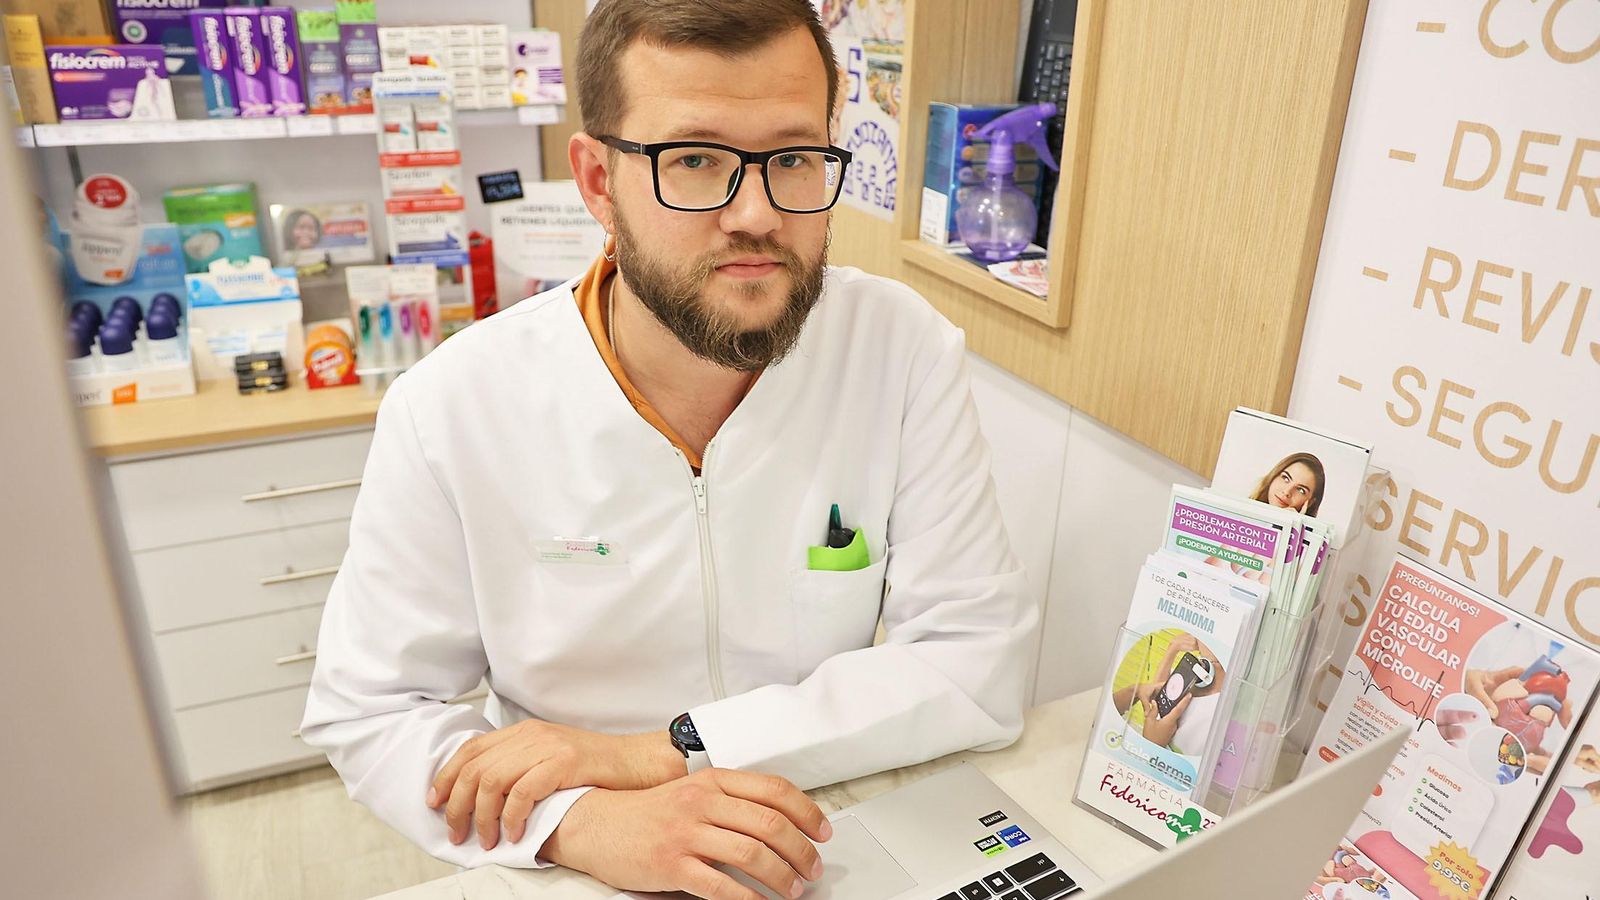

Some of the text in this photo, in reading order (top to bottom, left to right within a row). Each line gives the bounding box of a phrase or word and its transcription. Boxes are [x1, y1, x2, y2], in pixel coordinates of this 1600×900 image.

[51, 52, 126, 70] fisiocrem
[1443, 120, 1600, 218] DER
[1413, 246, 1600, 366] REVI
[1175, 508, 1276, 543] ¿PROBLEMAS CON TU
[1180, 517, 1268, 551] PRESIÓN ARTERIAL
[1178, 537, 1261, 568] ¡PODEMOS AYUDARTE!
[1155, 575, 1165, 585] DE
[1166, 580, 1186, 594] CADA
[1157, 597, 1215, 634] MELANOMA
[1166, 589, 1210, 613] DE PIEL SON
[1389, 585, 1461, 633] CALCULA
[1384, 598, 1448, 644] TU EDAD
[1369, 627, 1405, 657] CON
[1376, 612, 1461, 671] VASCULAR
[1362, 643, 1444, 699] MICROLIFE
[1371, 714, 1383, 725] con
[1107, 762, 1184, 809] FARMACIA
[1427, 766, 1462, 792] Medimos
[1429, 782, 1450, 799] Glucosa
[1420, 802, 1445, 822] Colesterol
[1433, 824, 1453, 840] Arterial
[1439, 851, 1474, 880] Por solo
